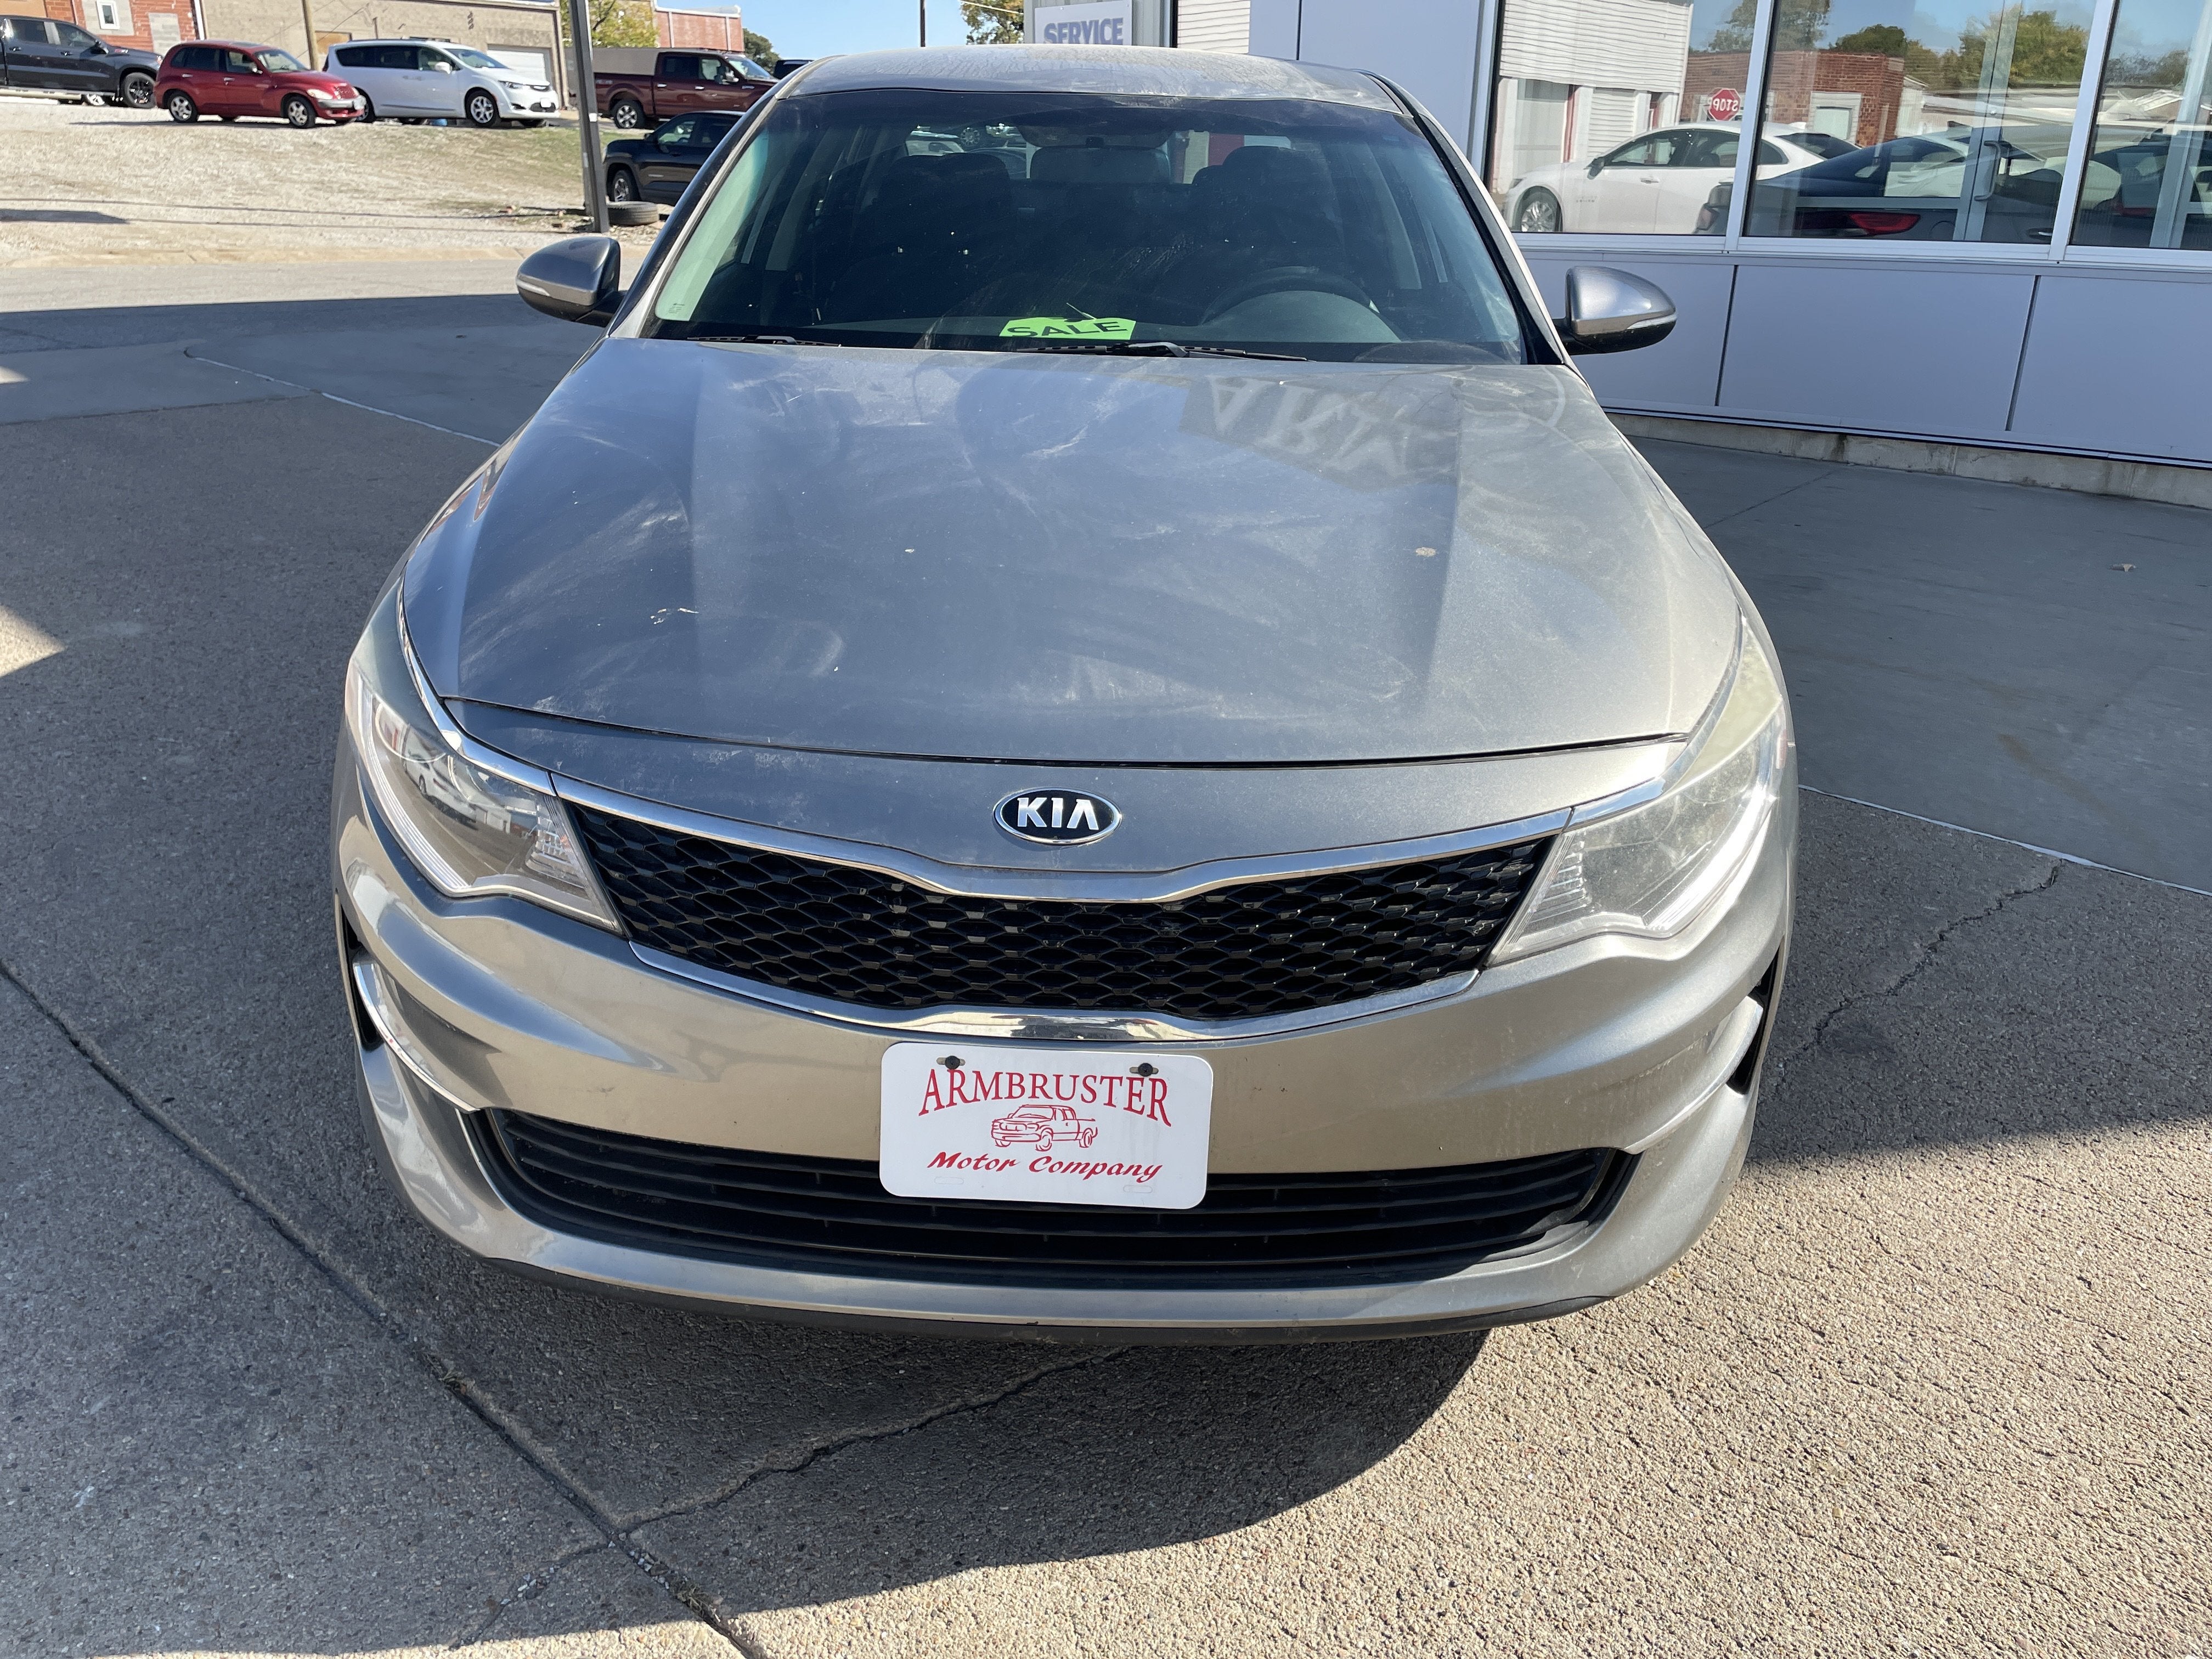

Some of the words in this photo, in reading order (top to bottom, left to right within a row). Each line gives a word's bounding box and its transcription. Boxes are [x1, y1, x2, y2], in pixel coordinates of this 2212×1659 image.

[1044, 18, 1124, 45] SERVICE
[1007, 321, 1127, 337] SALE
[1017, 797, 1099, 830] KIA
[918, 1068, 1172, 1127] ARMBRUSTER
[927, 1152, 1020, 1172] Motor
[1028, 1155, 1163, 1183] Company
